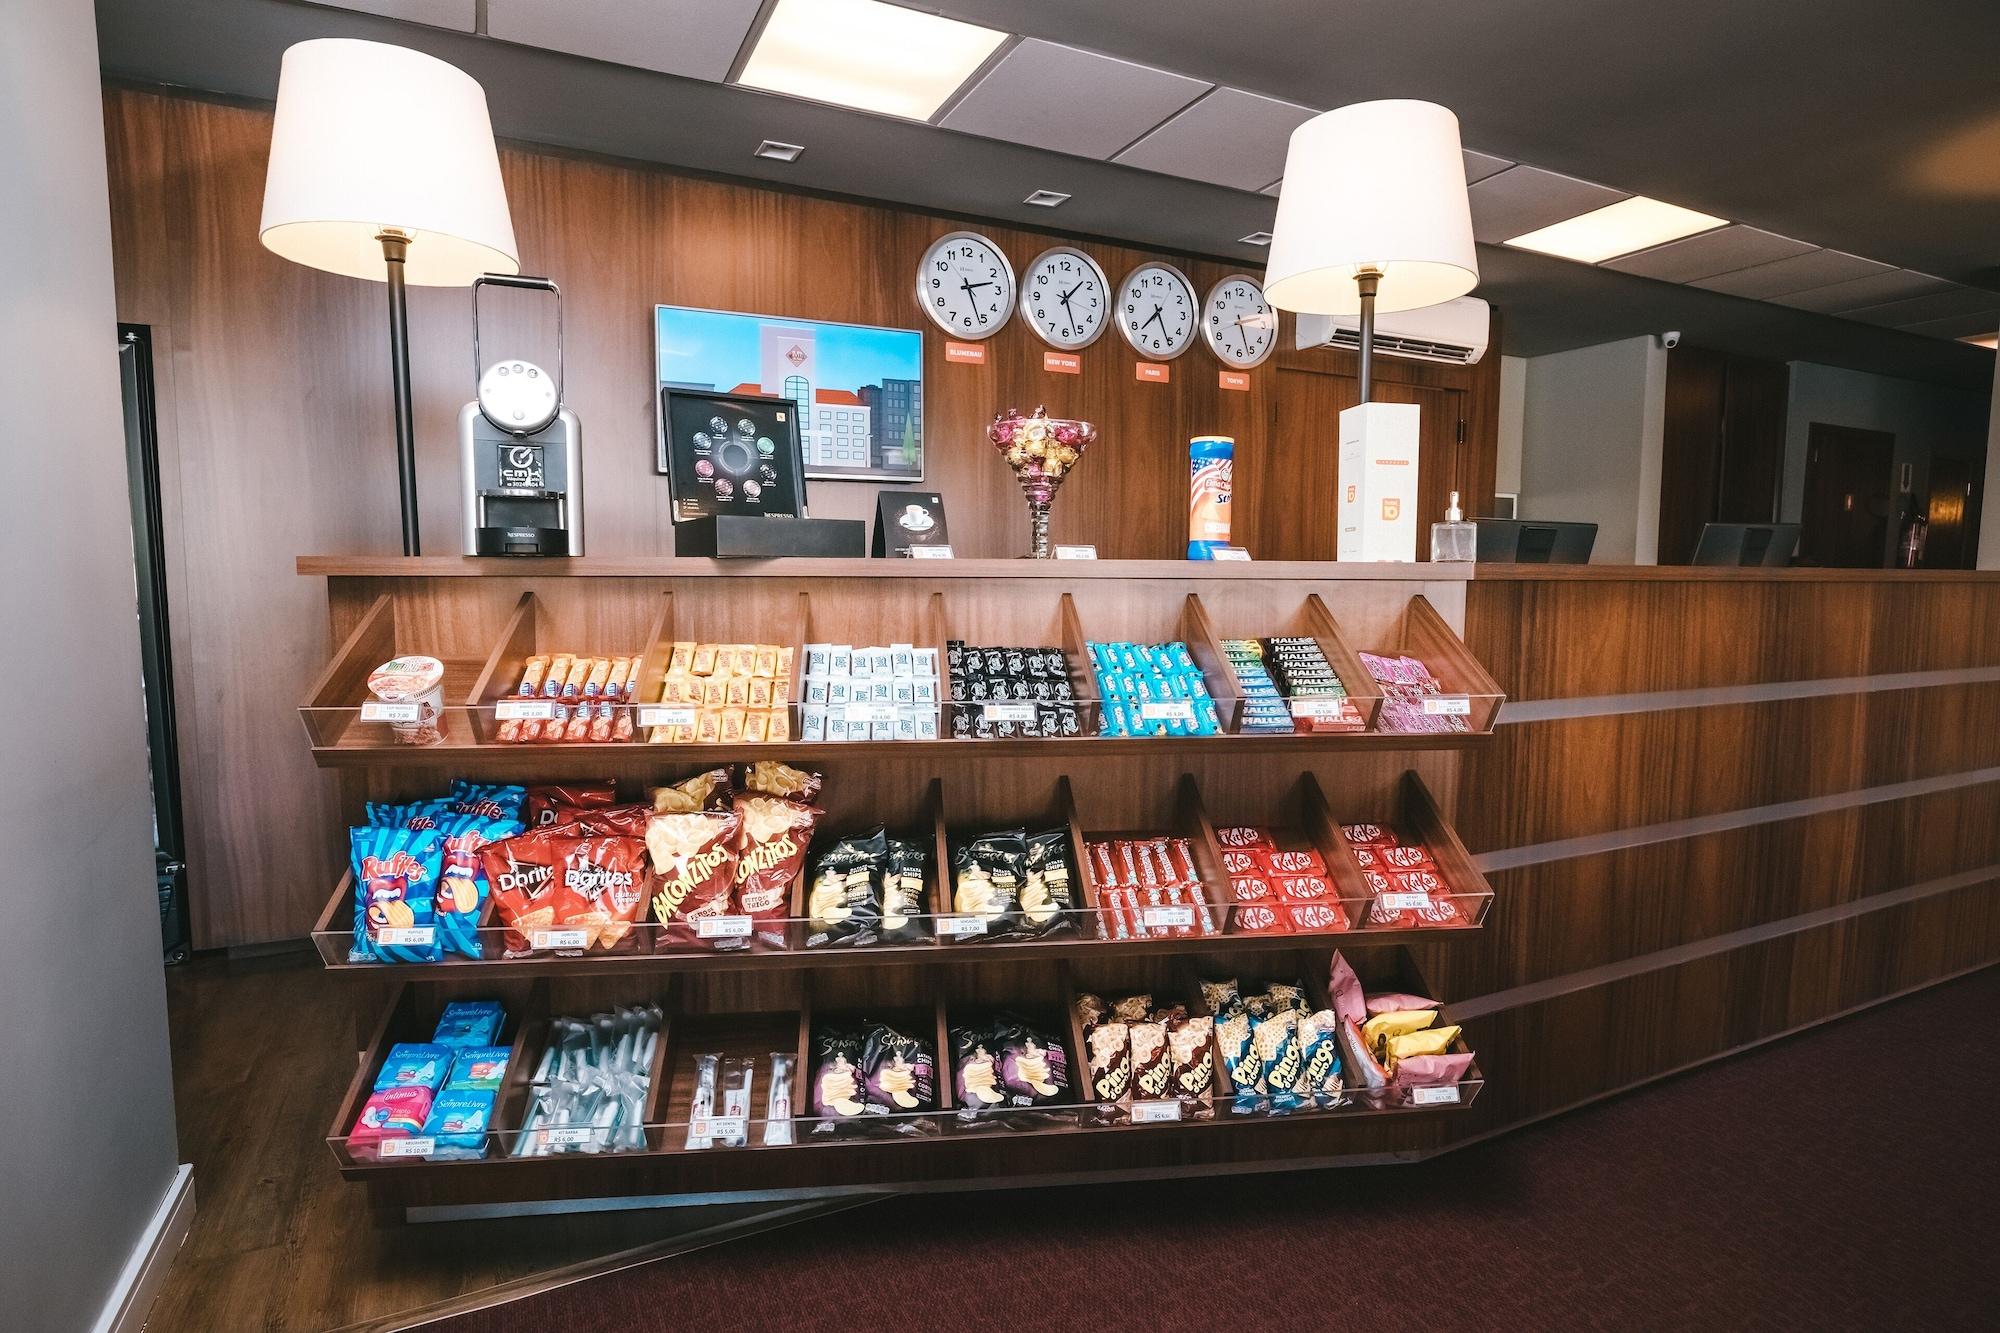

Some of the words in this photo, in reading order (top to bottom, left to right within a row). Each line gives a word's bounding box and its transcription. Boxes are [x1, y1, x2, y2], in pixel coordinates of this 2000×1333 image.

[947, 251, 955, 260] 11
[961, 247, 973, 257] 12
[980, 254, 983, 263] 1
[937, 261, 948, 271] 10
[1048, 265, 1055, 274] 11
[1060, 262, 1071, 271] 12
[990, 268, 997, 277] 2
[1077, 268, 1080, 276] 1
[932, 279, 940, 288] 9
[1037, 275, 1048, 285] 10
[1141, 279, 1148, 288] 11
[1153, 276, 1162, 285] 12
[995, 286, 1001, 295] 3
[1087, 282, 1093, 290] 2
[1168, 282, 1171, 290] 1
[1033, 292, 1040, 301] 9
[1132, 290, 1141, 298] 10
[1225, 291, 1231, 299] 11
[1235, 288, 1245, 296] 12
[937, 297, 945, 306] 8
[1177, 296, 1182, 304] 2
[1250, 293, 1253, 301] 1
[1091, 298, 1097, 307] 3
[1216, 301, 1225, 309] 10
[991, 304, 997, 312] 4
[1128, 305, 1134, 313] 9
[1257, 306, 1262, 314] 2
[949, 312, 957, 321] 7
[981, 314, 987, 323] 5
[1038, 310, 1045, 318] 8
[1180, 312, 1186, 320] 3
[964, 317, 971, 326] 6
[1086, 315, 1093, 323] 4
[1213, 316, 1218, 324] 9
[1049, 323, 1055, 332] 7
[1078, 326, 1083, 334] 5
[1132, 322, 1138, 330] 8
[1062, 328, 1069, 337] 6
[1216, 332, 1222, 340] 8
[1142, 335, 1147, 343] 7
[1154, 340, 1160, 348] 6
[950, 349, 982, 357] BLUMENAU
[1237, 349, 1242, 357] 6
[1250, 346, 1254, 354] 5
[362, 850, 427, 881] Ruffles
[565, 870, 632, 886] Doritos
[652, 842, 728, 929] BACONZITOS
[747, 900, 770, 909] TRIGO
[438, 1099, 487, 1109] SempreLivre
